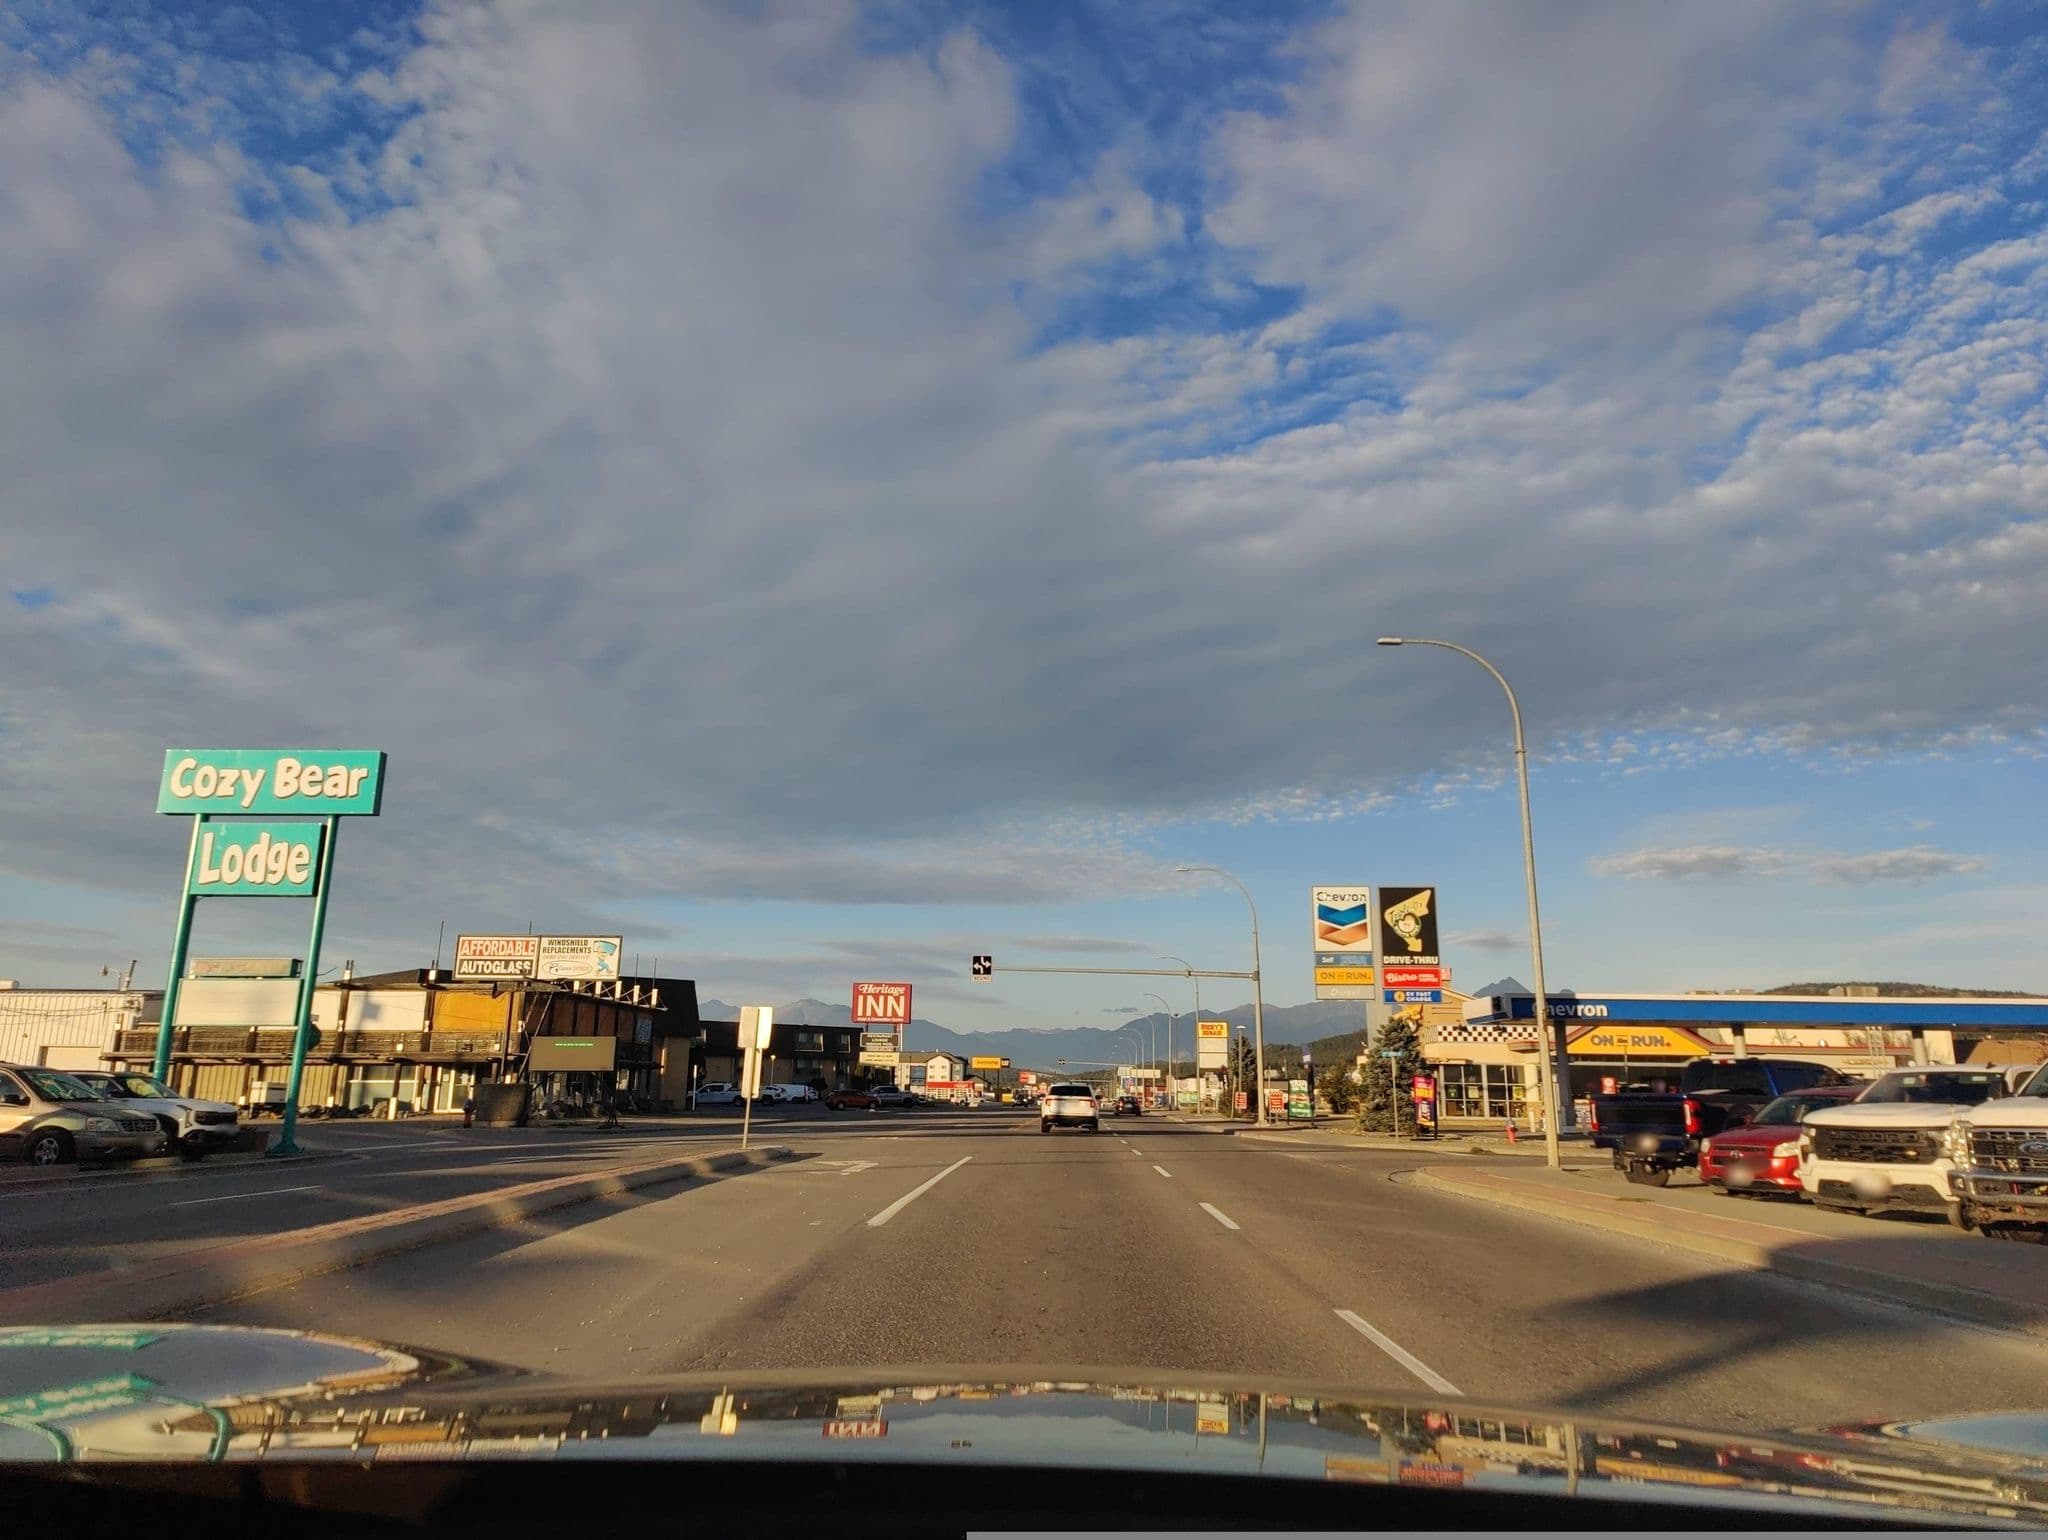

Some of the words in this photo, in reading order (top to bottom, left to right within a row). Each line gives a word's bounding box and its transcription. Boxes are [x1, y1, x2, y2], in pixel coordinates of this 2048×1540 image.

[170, 757, 266, 809] Cozy
[274, 757, 368, 799] Bear
[198, 831, 310, 885] Lodge
[1316, 891, 1367, 902] Chevron
[461, 939, 536, 957] AFFORDABLE
[1383, 955, 1439, 965] DRIVE-THRU
[459, 960, 532, 975] AUTOGLASS
[1320, 972, 1335, 980] ON
[858, 983, 906, 997] Heritage
[856, 994, 906, 1018] INN
[1590, 1034, 1614, 1046] ON
